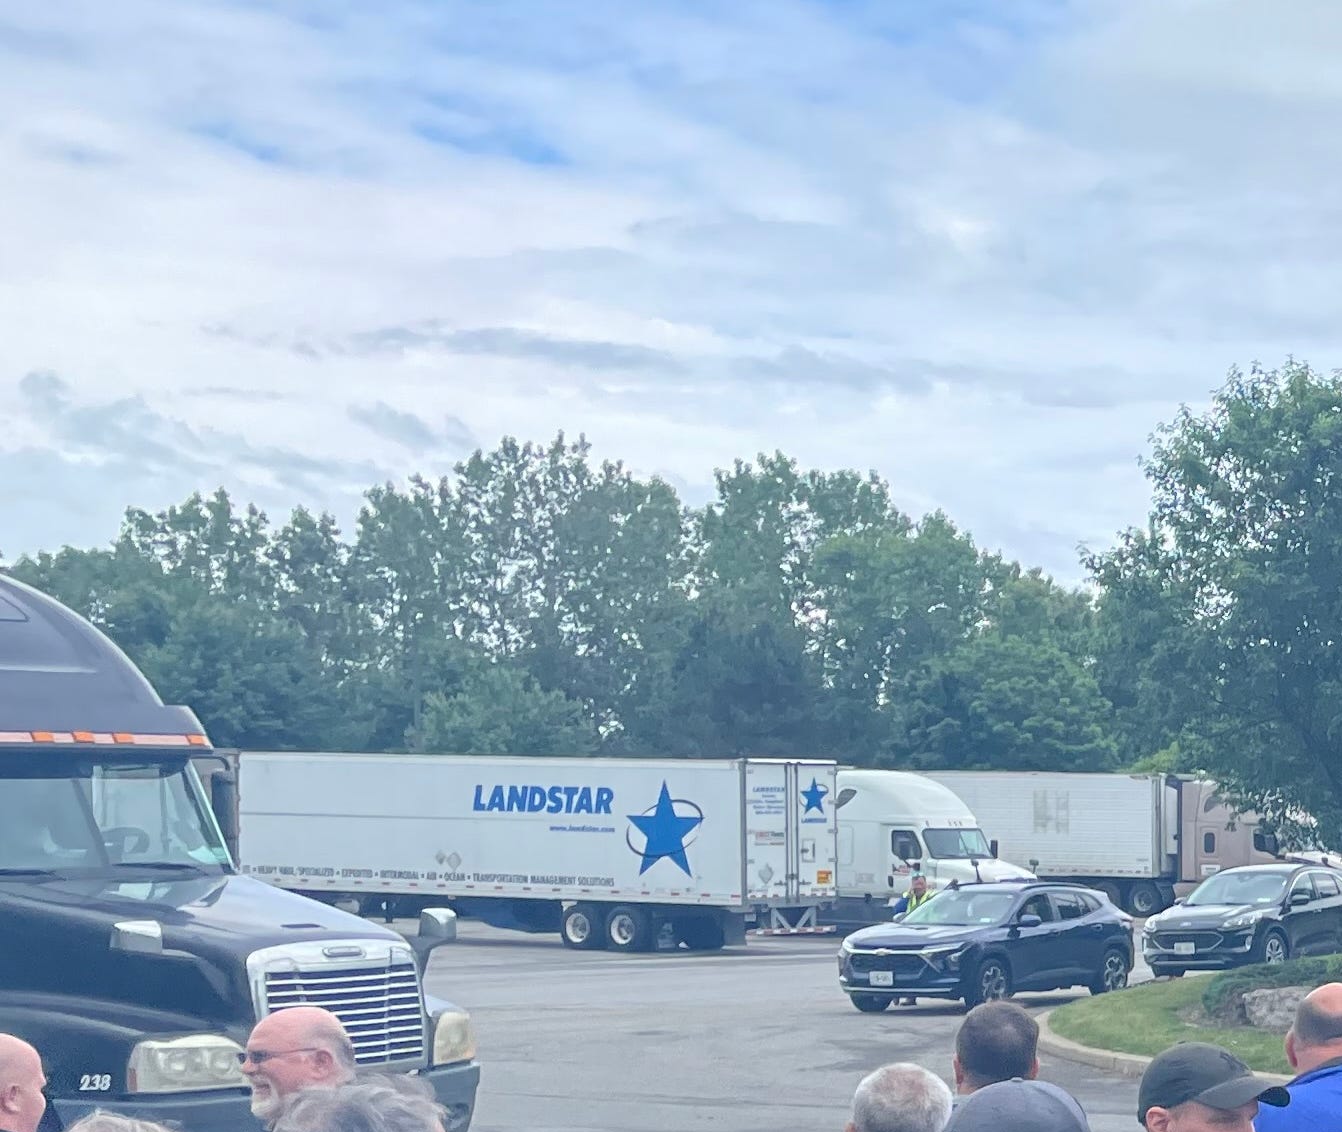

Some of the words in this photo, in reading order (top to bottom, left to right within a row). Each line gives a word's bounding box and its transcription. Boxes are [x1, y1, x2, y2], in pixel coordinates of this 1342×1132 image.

[473, 784, 614, 814] LANDSTAR
[473, 872, 529, 884] TRANSPORTATION
[530, 875, 576, 886] MANAGEMENT
[577, 876, 615, 887] SOLUTIONS
[79, 1073, 112, 1091] 238
